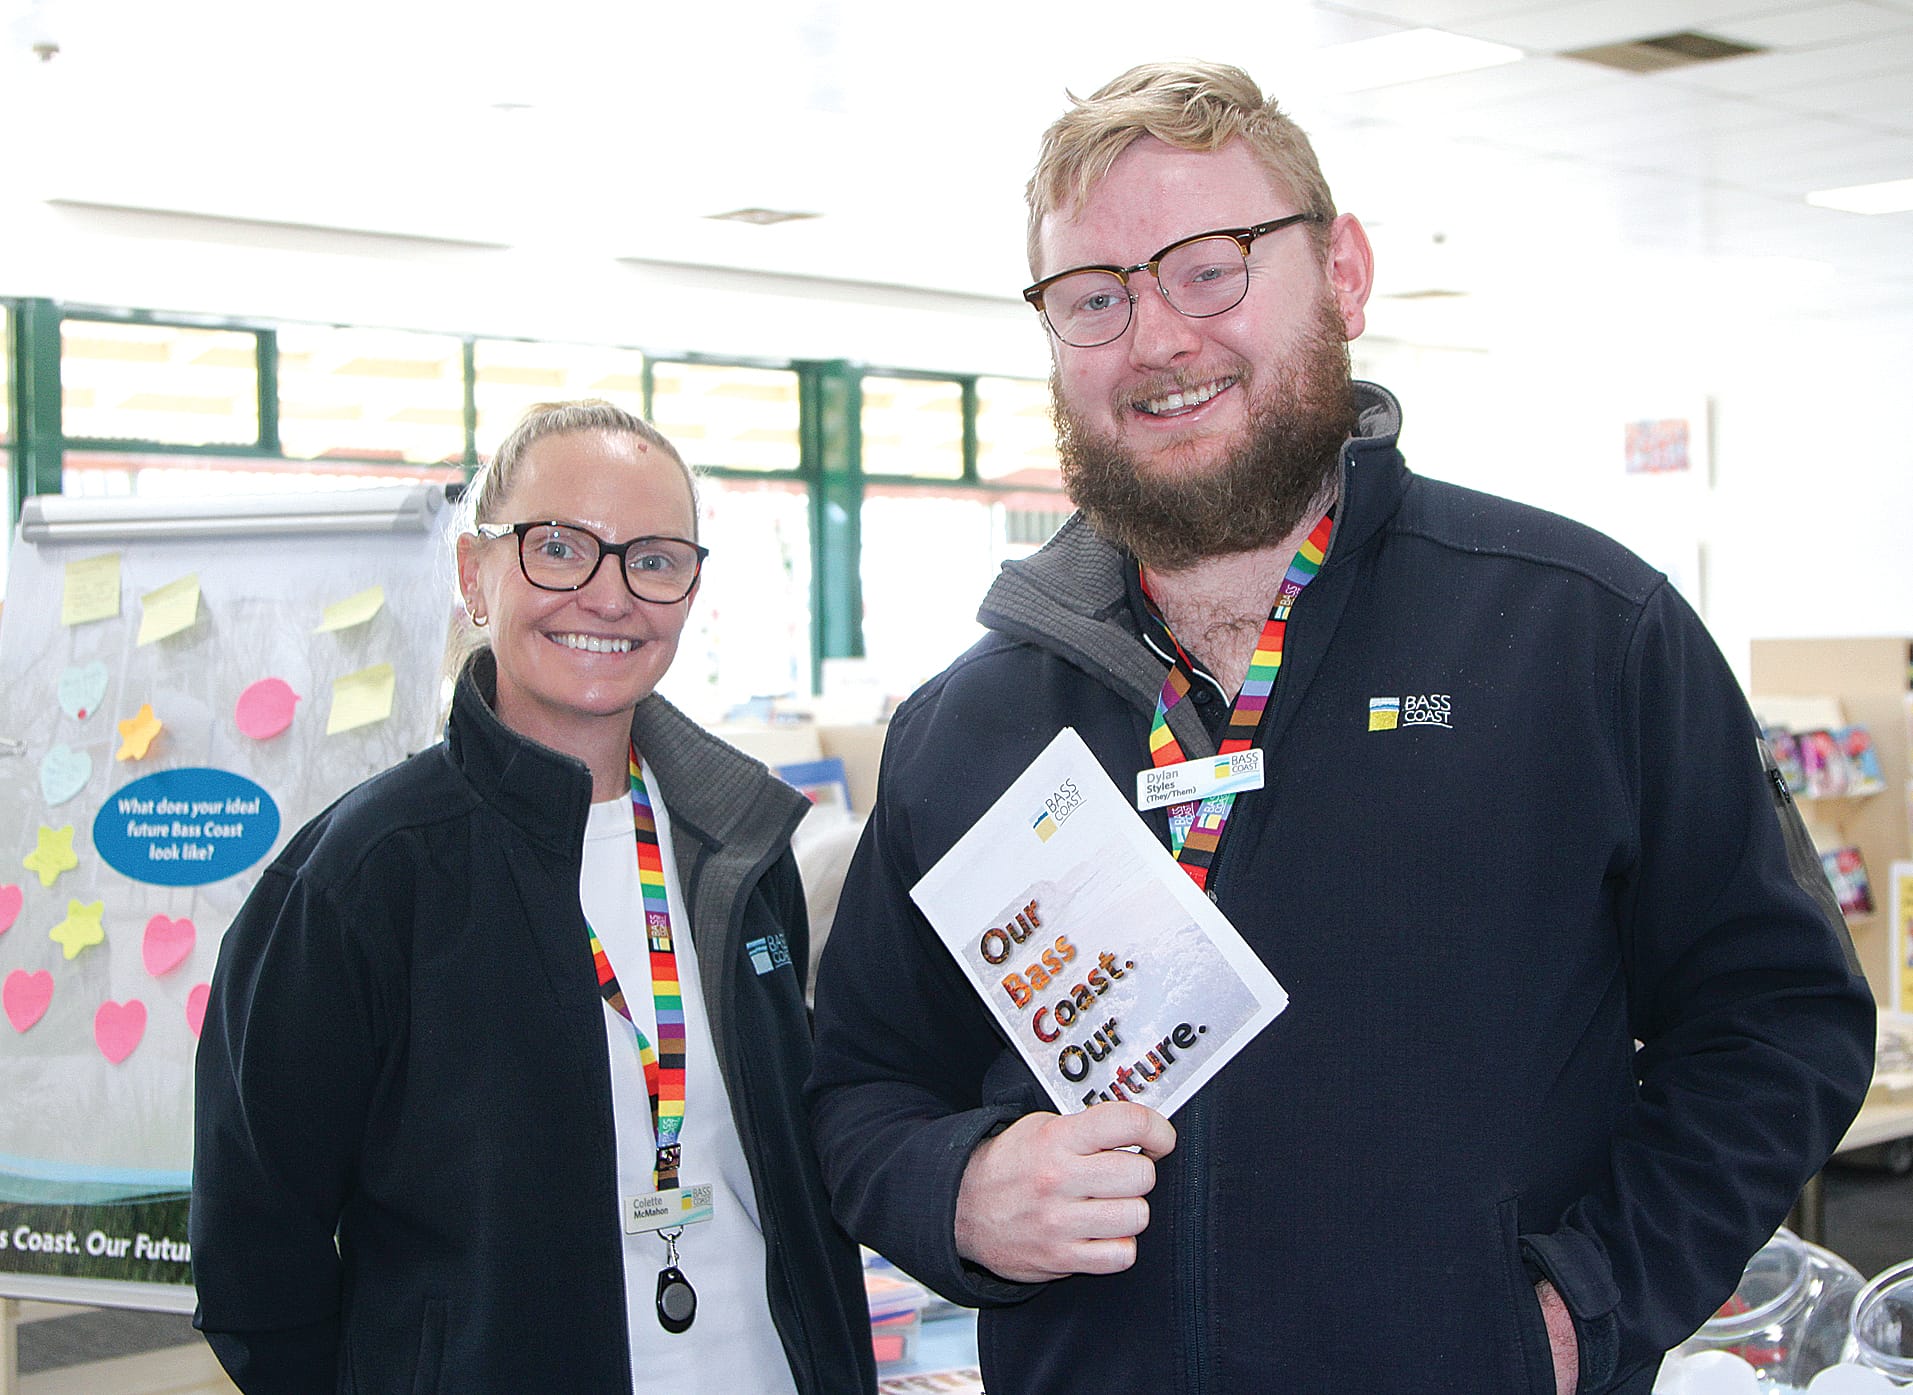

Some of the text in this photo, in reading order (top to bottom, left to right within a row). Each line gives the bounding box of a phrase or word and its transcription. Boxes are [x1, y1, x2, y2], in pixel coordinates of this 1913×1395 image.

[1404, 694, 1452, 711] BASS
[1404, 710, 1452, 723] COAST
[1231, 752, 1259, 766] BASS
[1146, 769, 1179, 784] Dylan
[1231, 763, 1259, 774] COAST
[1045, 777, 1077, 813] BASS
[1146, 781, 1176, 794] Styles
[1146, 786, 1197, 804] (They/Them)
[118, 796, 261, 818] What does your ideal
[1054, 790, 1082, 821] COAST
[127, 820, 243, 838] future Bass Coast
[149, 843, 214, 861] look like?
[650, 914, 661, 937] BASS
[980, 899, 1041, 965] Our
[1001, 935, 1075, 1010] Bass
[1032, 951, 1135, 1043] Coast.
[1058, 1017, 1122, 1083] Our
[692, 1186, 711, 1198] BASS
[633, 1197, 662, 1209] Colette
[634, 1207, 669, 1219] McMahon
[13, 1225, 80, 1254] Coast.
[86, 1231, 131, 1257] Our
[135, 1233, 191, 1262] Futur
